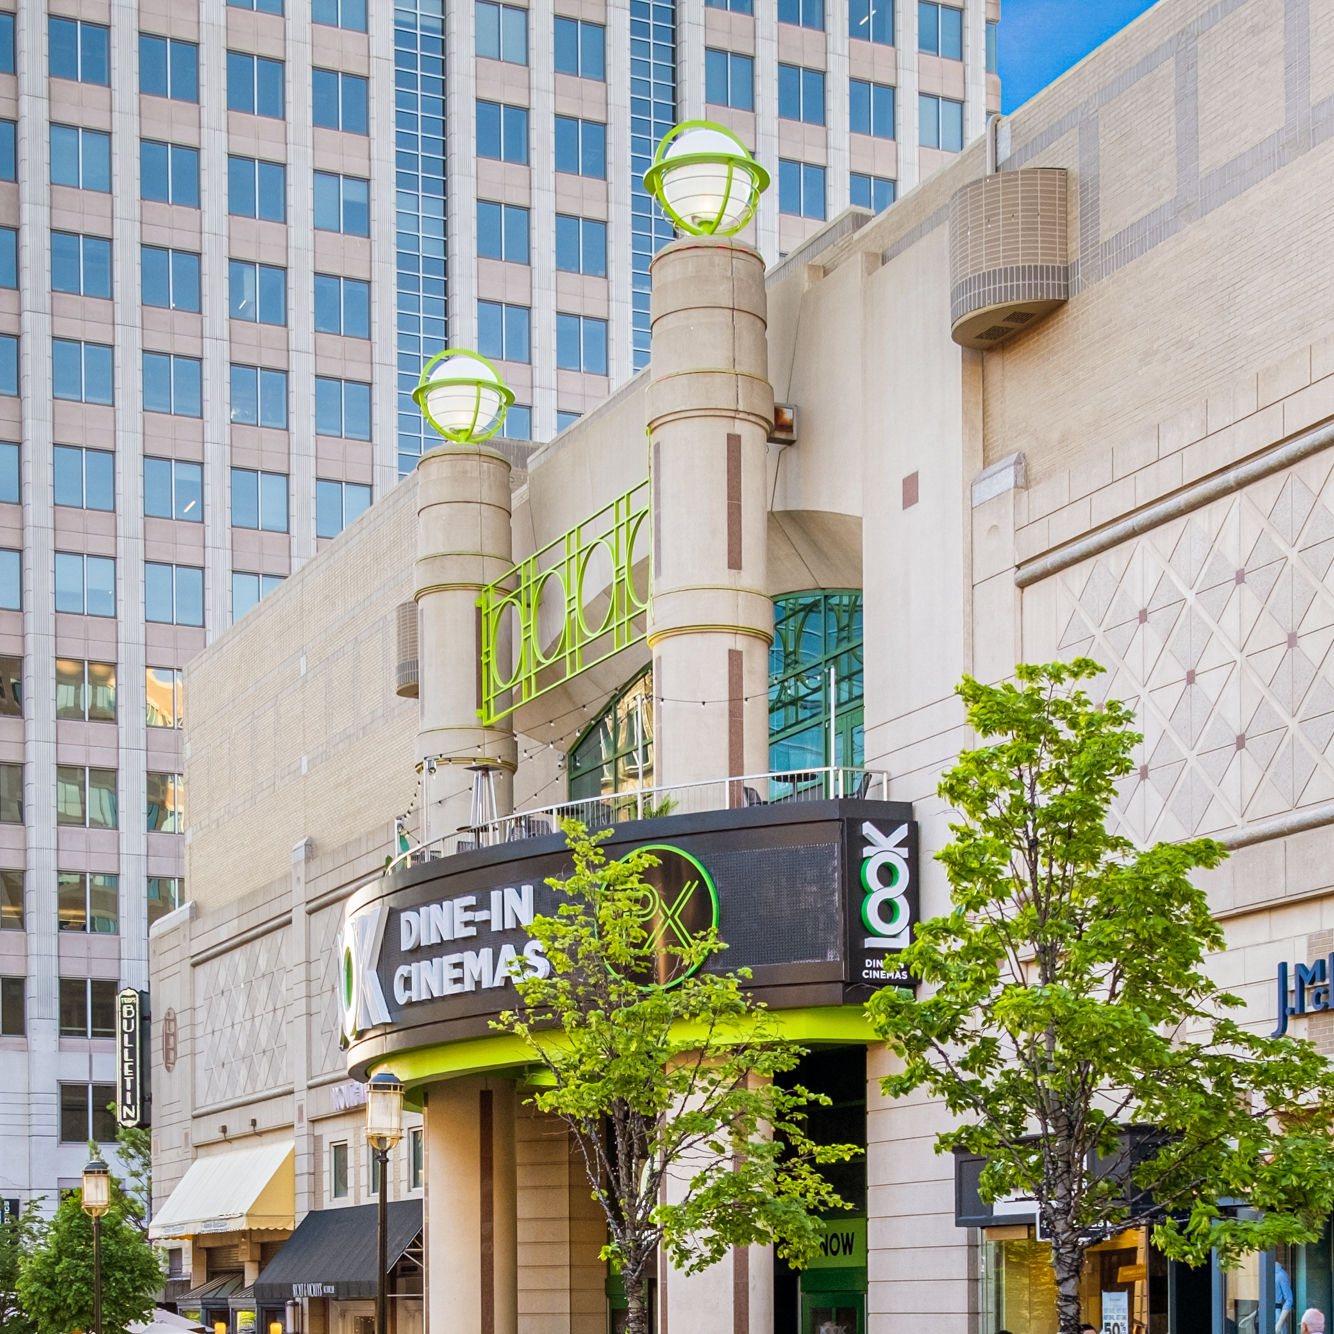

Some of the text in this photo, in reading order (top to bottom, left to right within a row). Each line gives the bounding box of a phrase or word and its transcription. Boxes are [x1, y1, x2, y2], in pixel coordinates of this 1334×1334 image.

[399, 884, 535, 952] DINE-IN
[861, 820, 911, 949] LOOK
[338, 905, 393, 1047] OK
[393, 939, 551, 1006] CINEMAS
[862, 970, 908, 980] CINEMAS
[865, 959, 905, 969] DINN
[122, 1004, 136, 1119] BULLETIN
[819, 1232, 855, 1256] NOW
